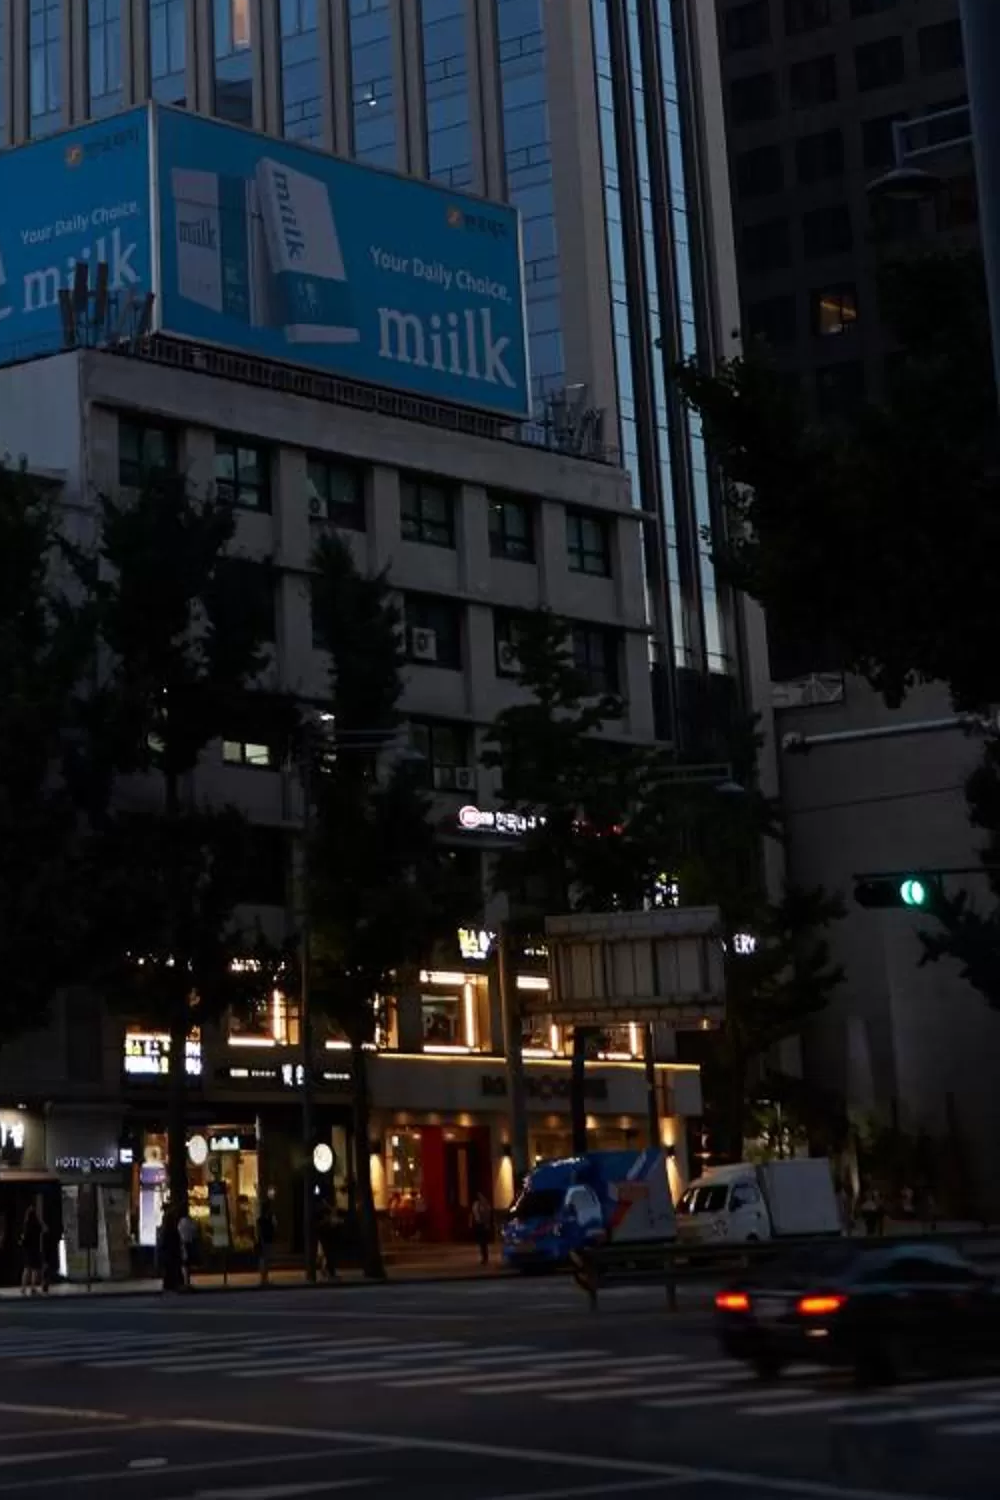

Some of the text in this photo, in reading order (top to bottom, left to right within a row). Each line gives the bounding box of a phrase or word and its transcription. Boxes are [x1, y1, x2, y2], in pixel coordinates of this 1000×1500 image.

[20, 226, 53, 245] Your
[55, 212, 89, 236] Daily
[369, 244, 409, 273] Your
[412, 257, 452, 291] Daily
[377, 307, 517, 389] miilk
[55, 1156, 86, 1168] HOTE
